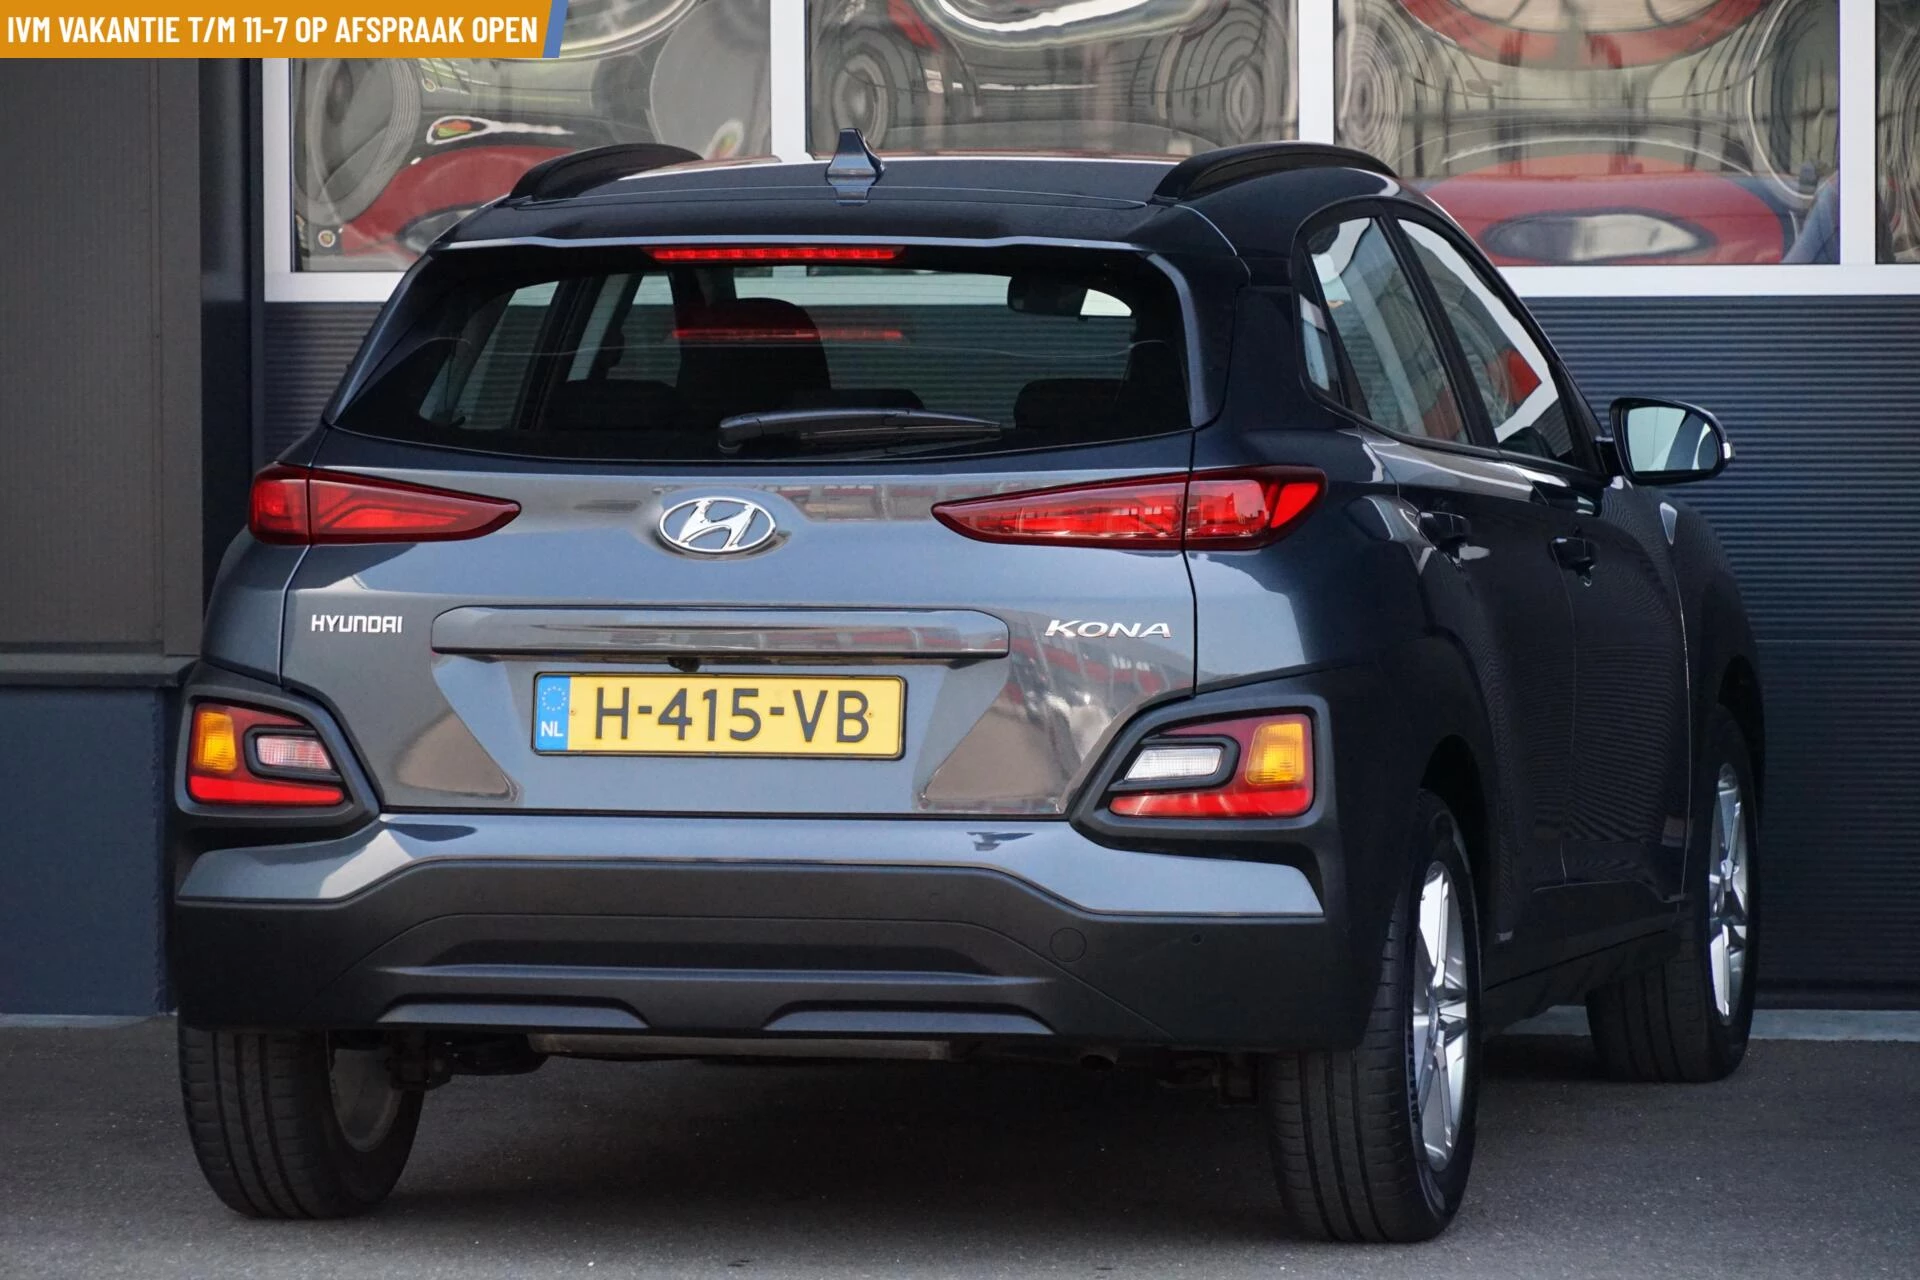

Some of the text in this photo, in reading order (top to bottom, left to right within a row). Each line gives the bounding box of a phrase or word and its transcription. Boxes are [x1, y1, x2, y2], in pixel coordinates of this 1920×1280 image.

[311, 615, 403, 634] HYUNDAI
[1045, 619, 1172, 638] KONA
[540, 687, 870, 743] NL H-415-VB
